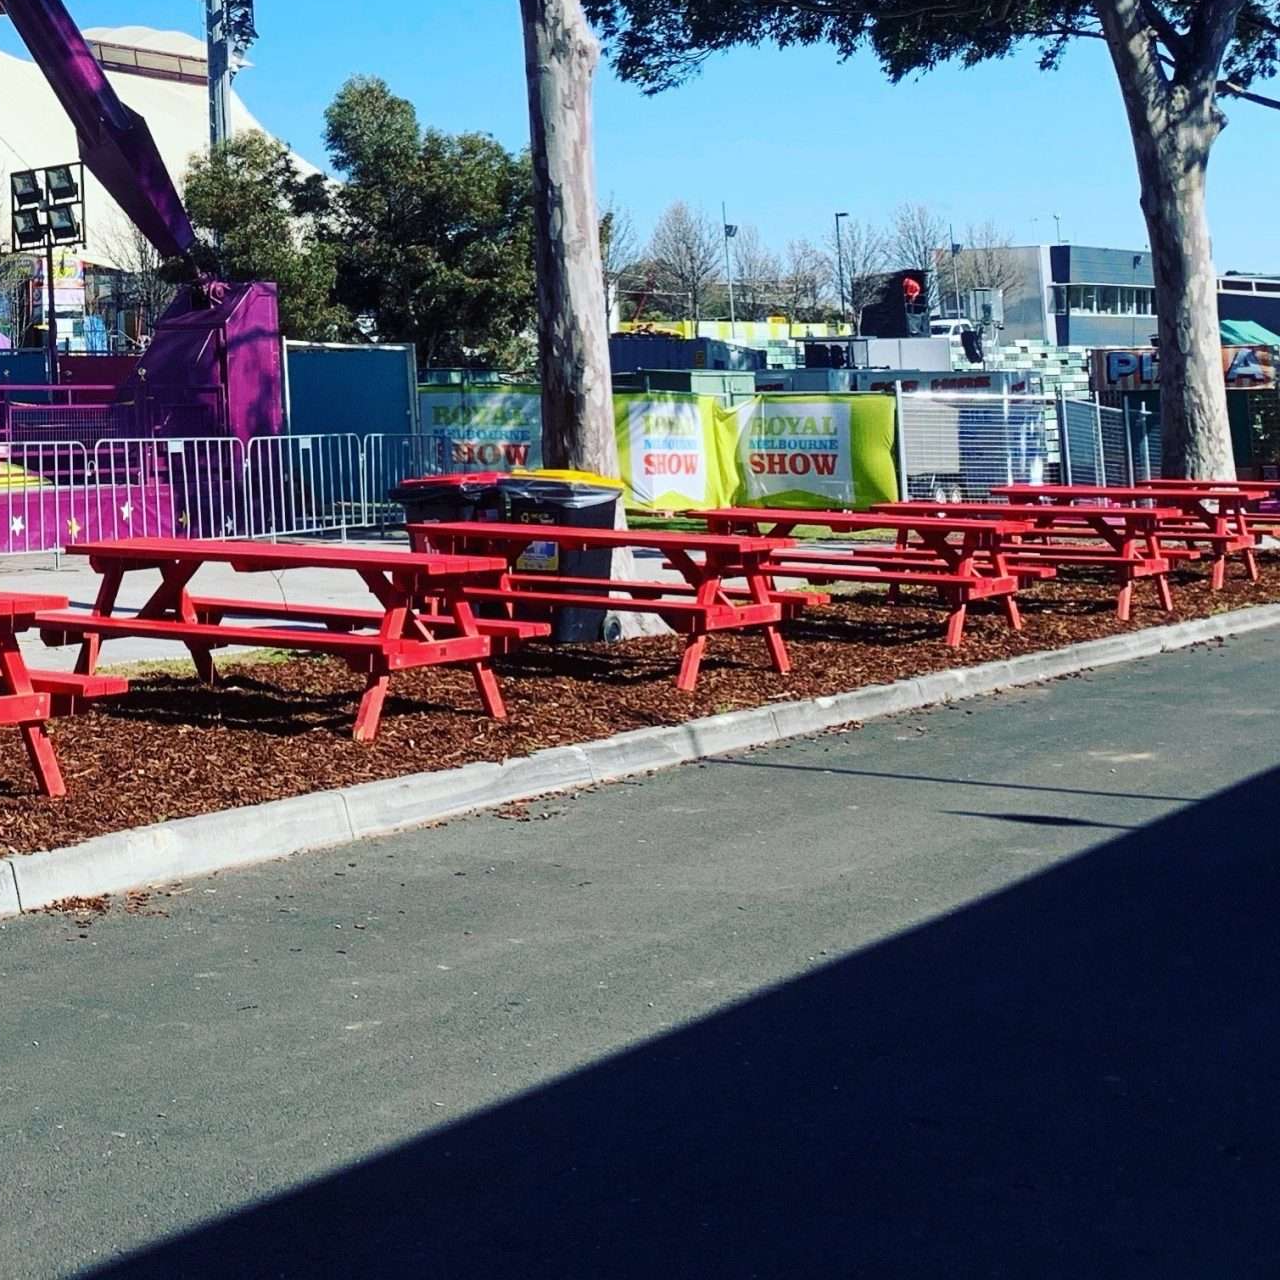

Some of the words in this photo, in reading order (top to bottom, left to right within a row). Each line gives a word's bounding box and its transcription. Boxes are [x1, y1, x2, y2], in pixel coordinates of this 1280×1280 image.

[1107, 348, 1267, 385] PIA
[750, 415, 838, 436] ROYAL
[749, 438, 839, 450] MELBOURNE
[643, 452, 699, 476] SHOW
[749, 452, 839, 476] SHOW
